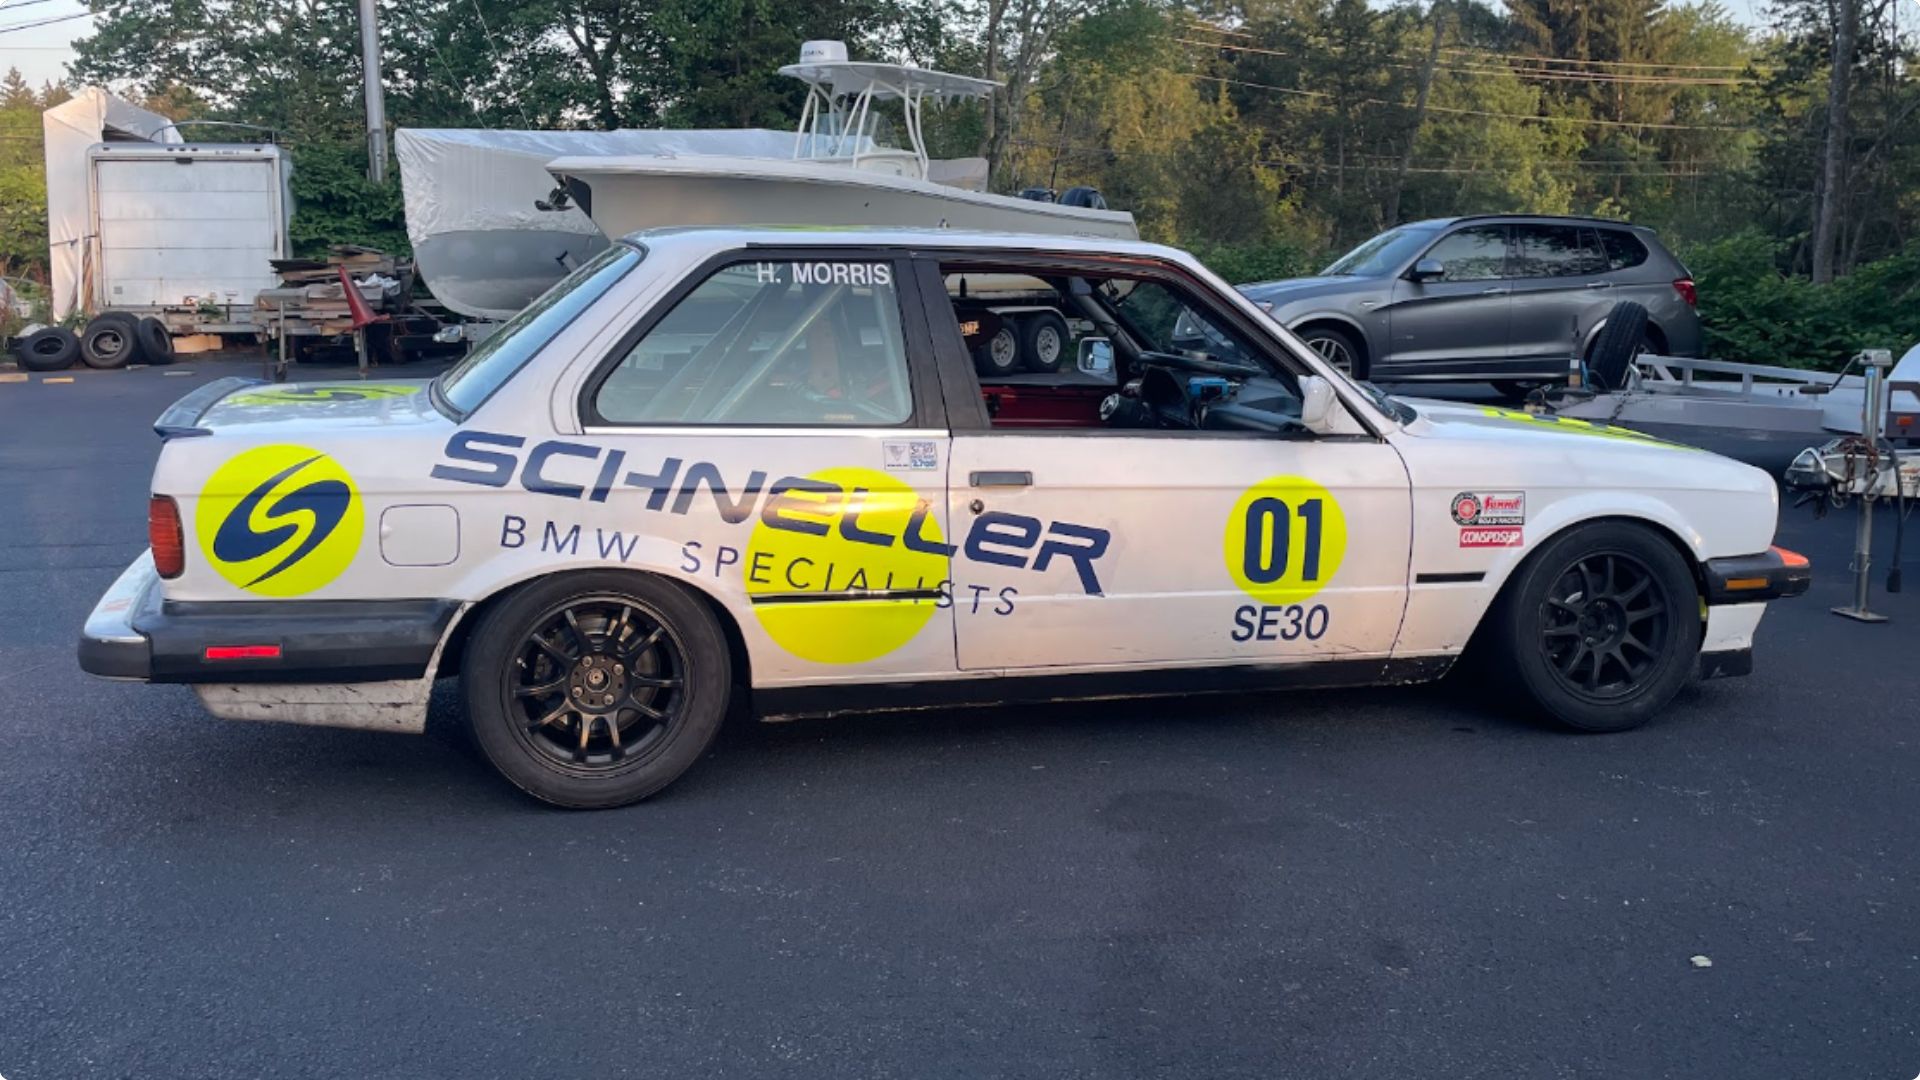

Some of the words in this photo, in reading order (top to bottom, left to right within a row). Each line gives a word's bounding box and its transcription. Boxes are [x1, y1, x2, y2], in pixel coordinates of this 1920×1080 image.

[756, 262, 781, 283] H.
[792, 262, 890, 285] MORRIS
[500, 515, 640, 562] BMW
[1243, 497, 1323, 583] 01
[680, 541, 1019, 616] SPECIALISTS
[1231, 604, 1330, 642] SE30
